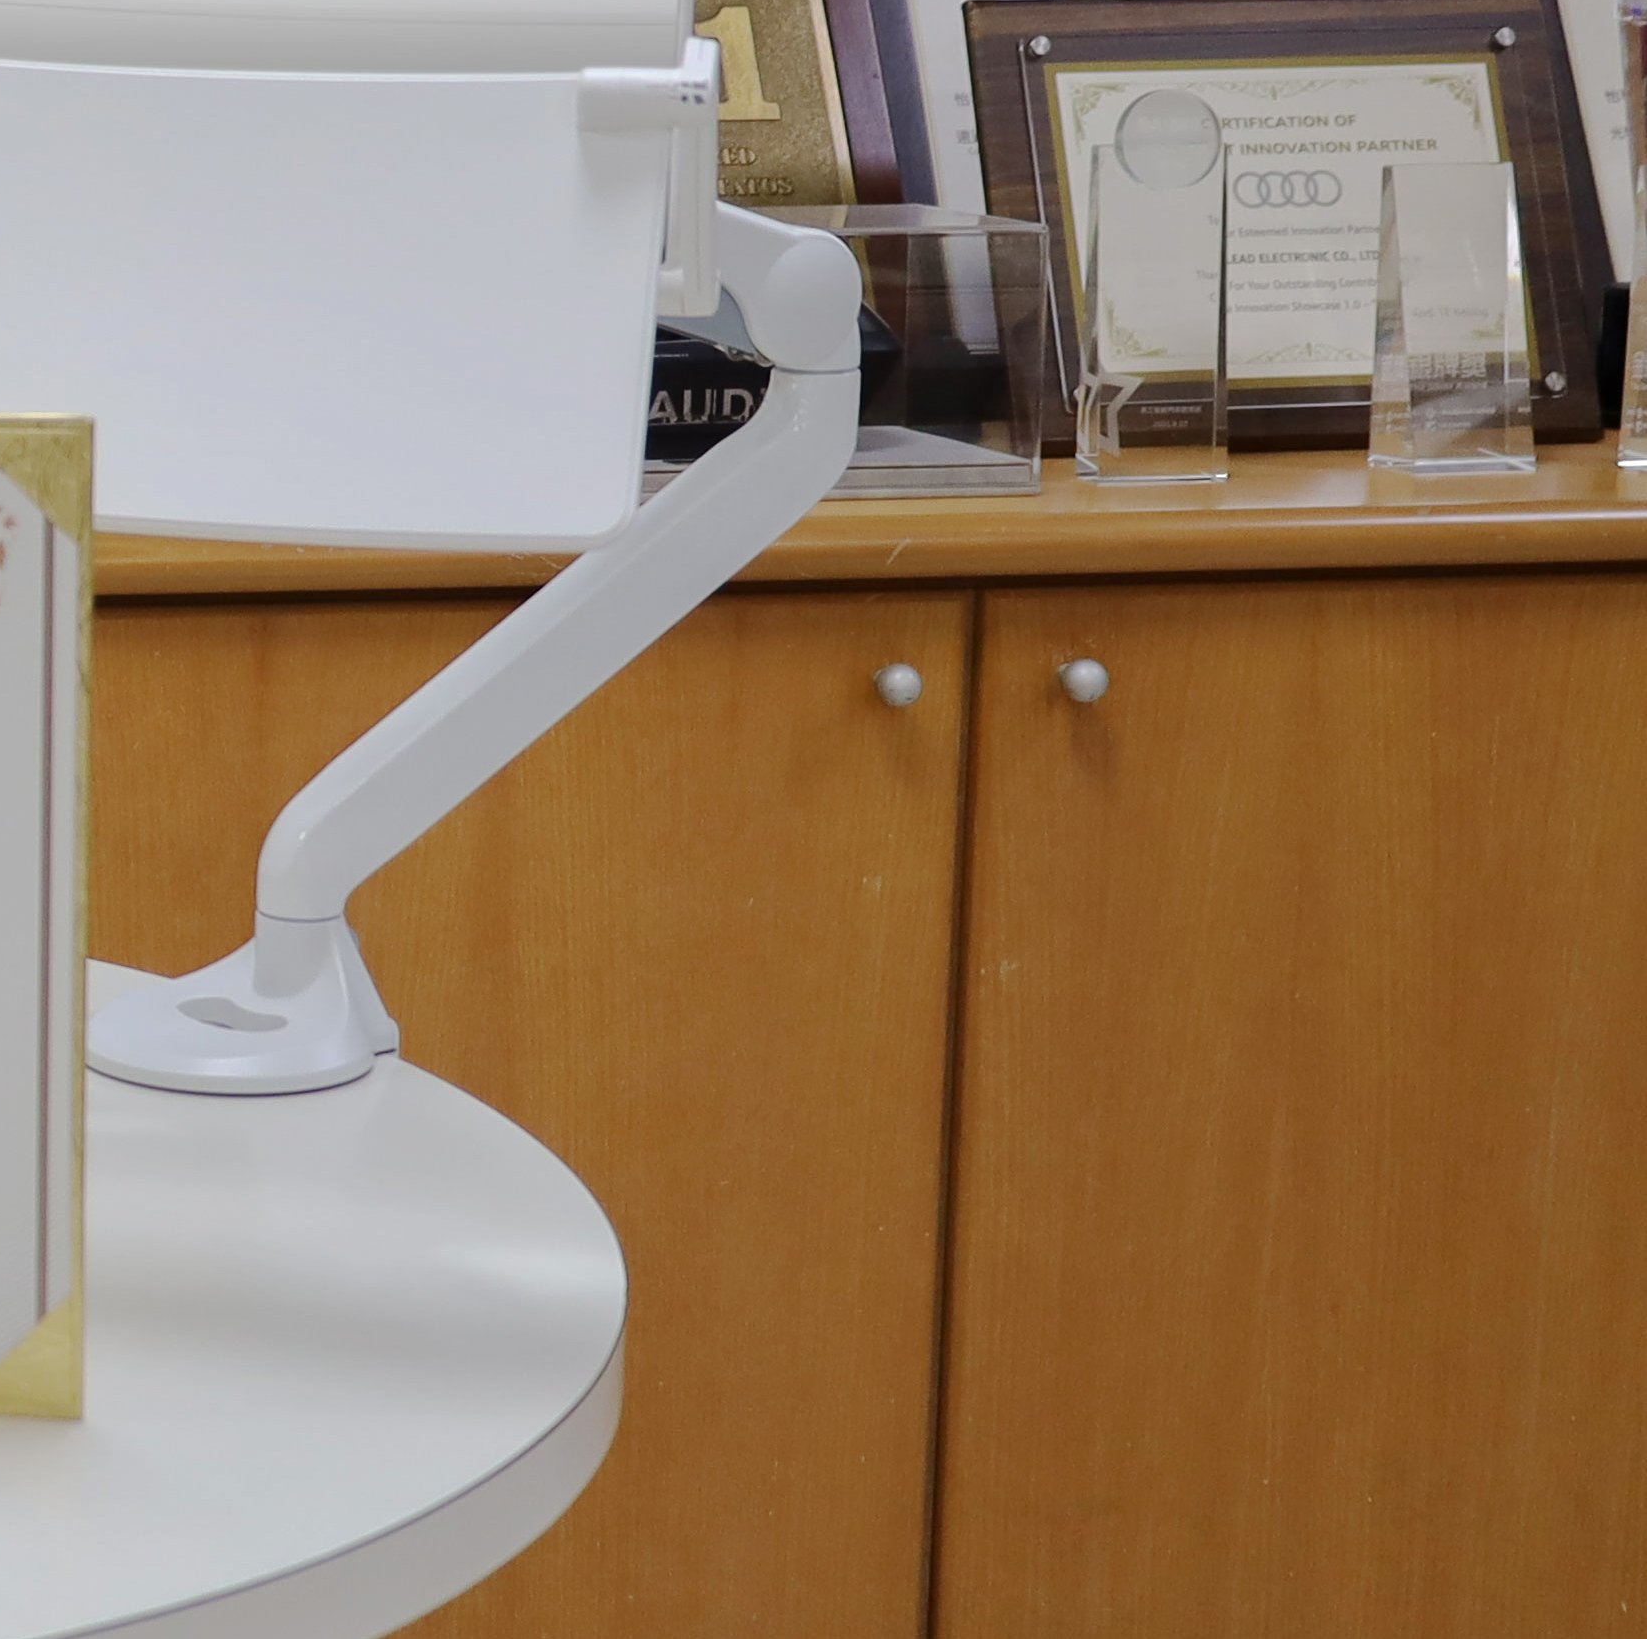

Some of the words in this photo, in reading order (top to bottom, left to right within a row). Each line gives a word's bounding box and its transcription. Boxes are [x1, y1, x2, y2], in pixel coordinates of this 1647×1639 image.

[1334, 114, 1357, 128] OF
[1240, 140, 1352, 156] INNOVATION
[1356, 138, 1438, 153] PARTNER
[1291, 225, 1344, 237] Innovation
[1259, 251, 1330, 264] ELECTRONIC
[1273, 278, 1337, 292] Outstanding
[648, 388, 766, 423] AUD
